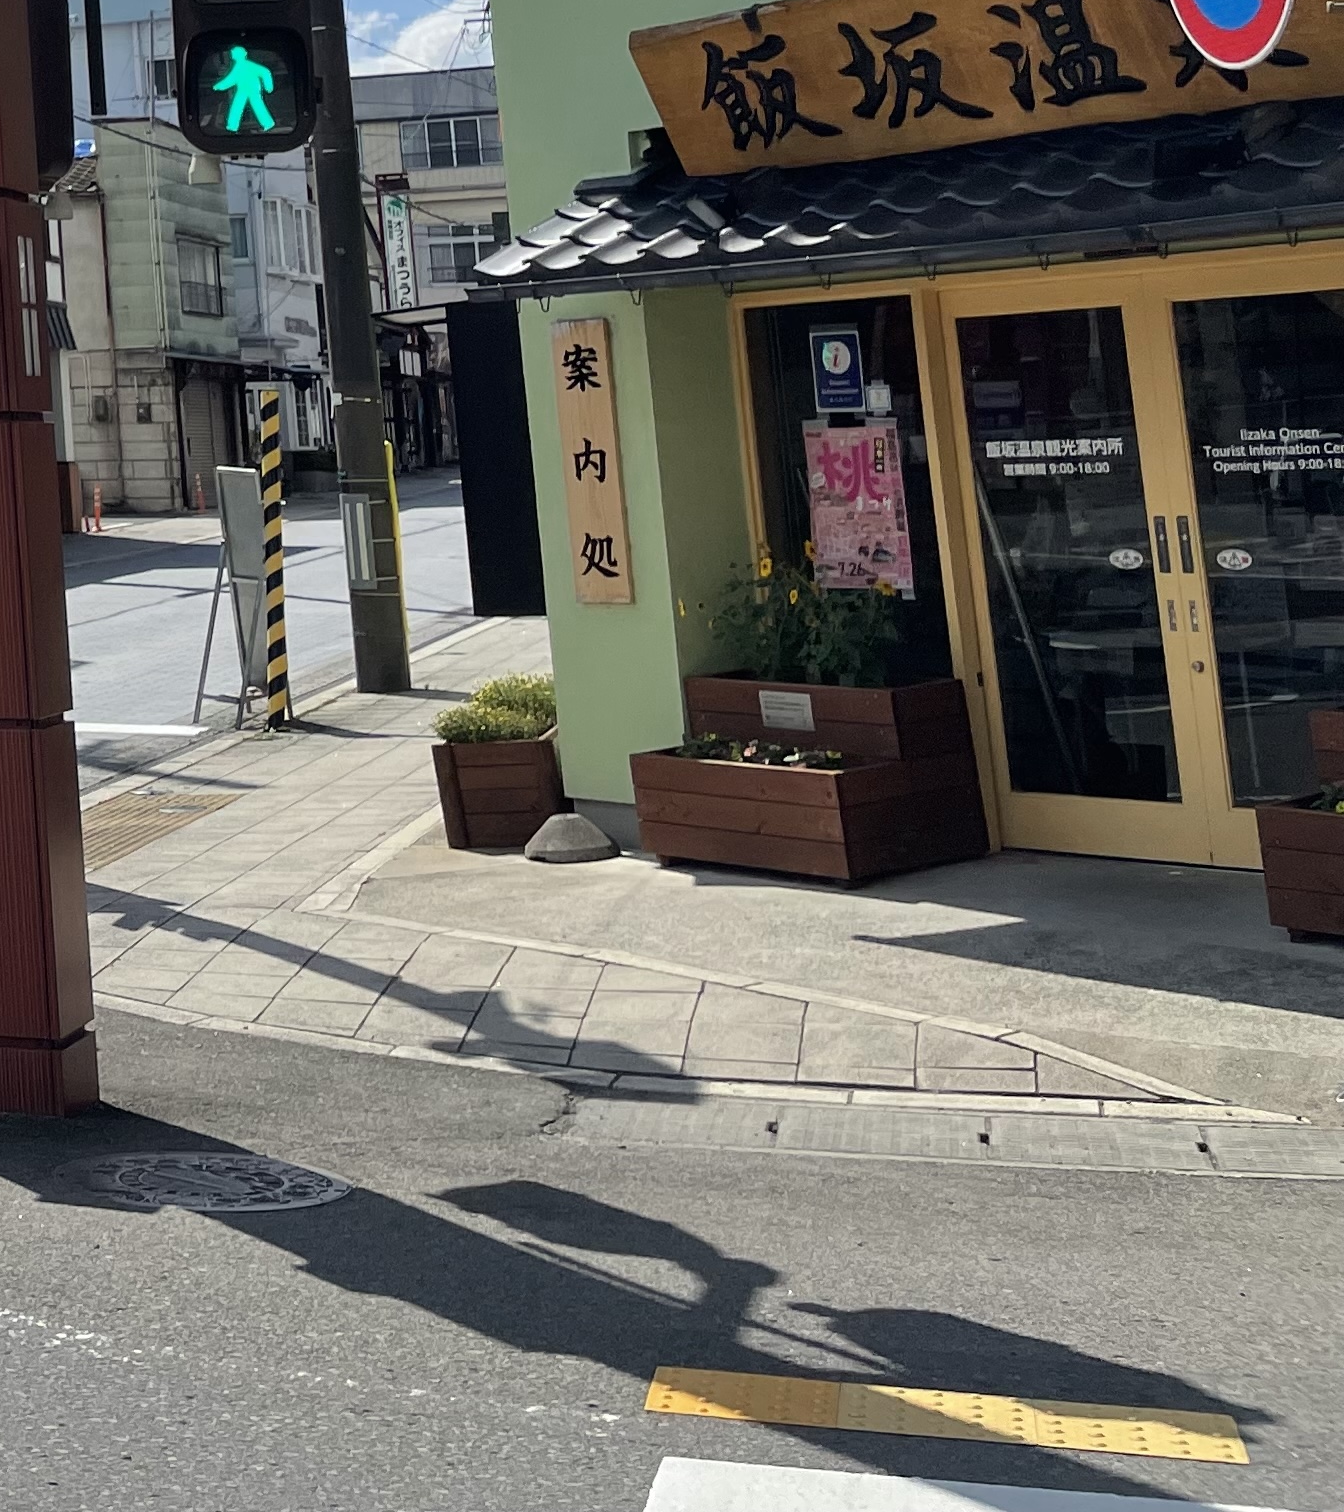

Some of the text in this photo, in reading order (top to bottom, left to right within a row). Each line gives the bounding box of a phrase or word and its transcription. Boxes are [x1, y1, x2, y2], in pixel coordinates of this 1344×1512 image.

[1279, 427, 1320, 439] Onsen
[985, 437, 1124, 458] 飯坂温泉観光案内所
[1203, 444, 1247, 458] Tourist
[1249, 443, 1321, 457] Information
[561, 344, 621, 579] 案内処
[1049, 462, 1110, 474] 9:00-18:00
[1213, 460, 1261, 475] Opening
[1263, 459, 1296, 471] Hours
